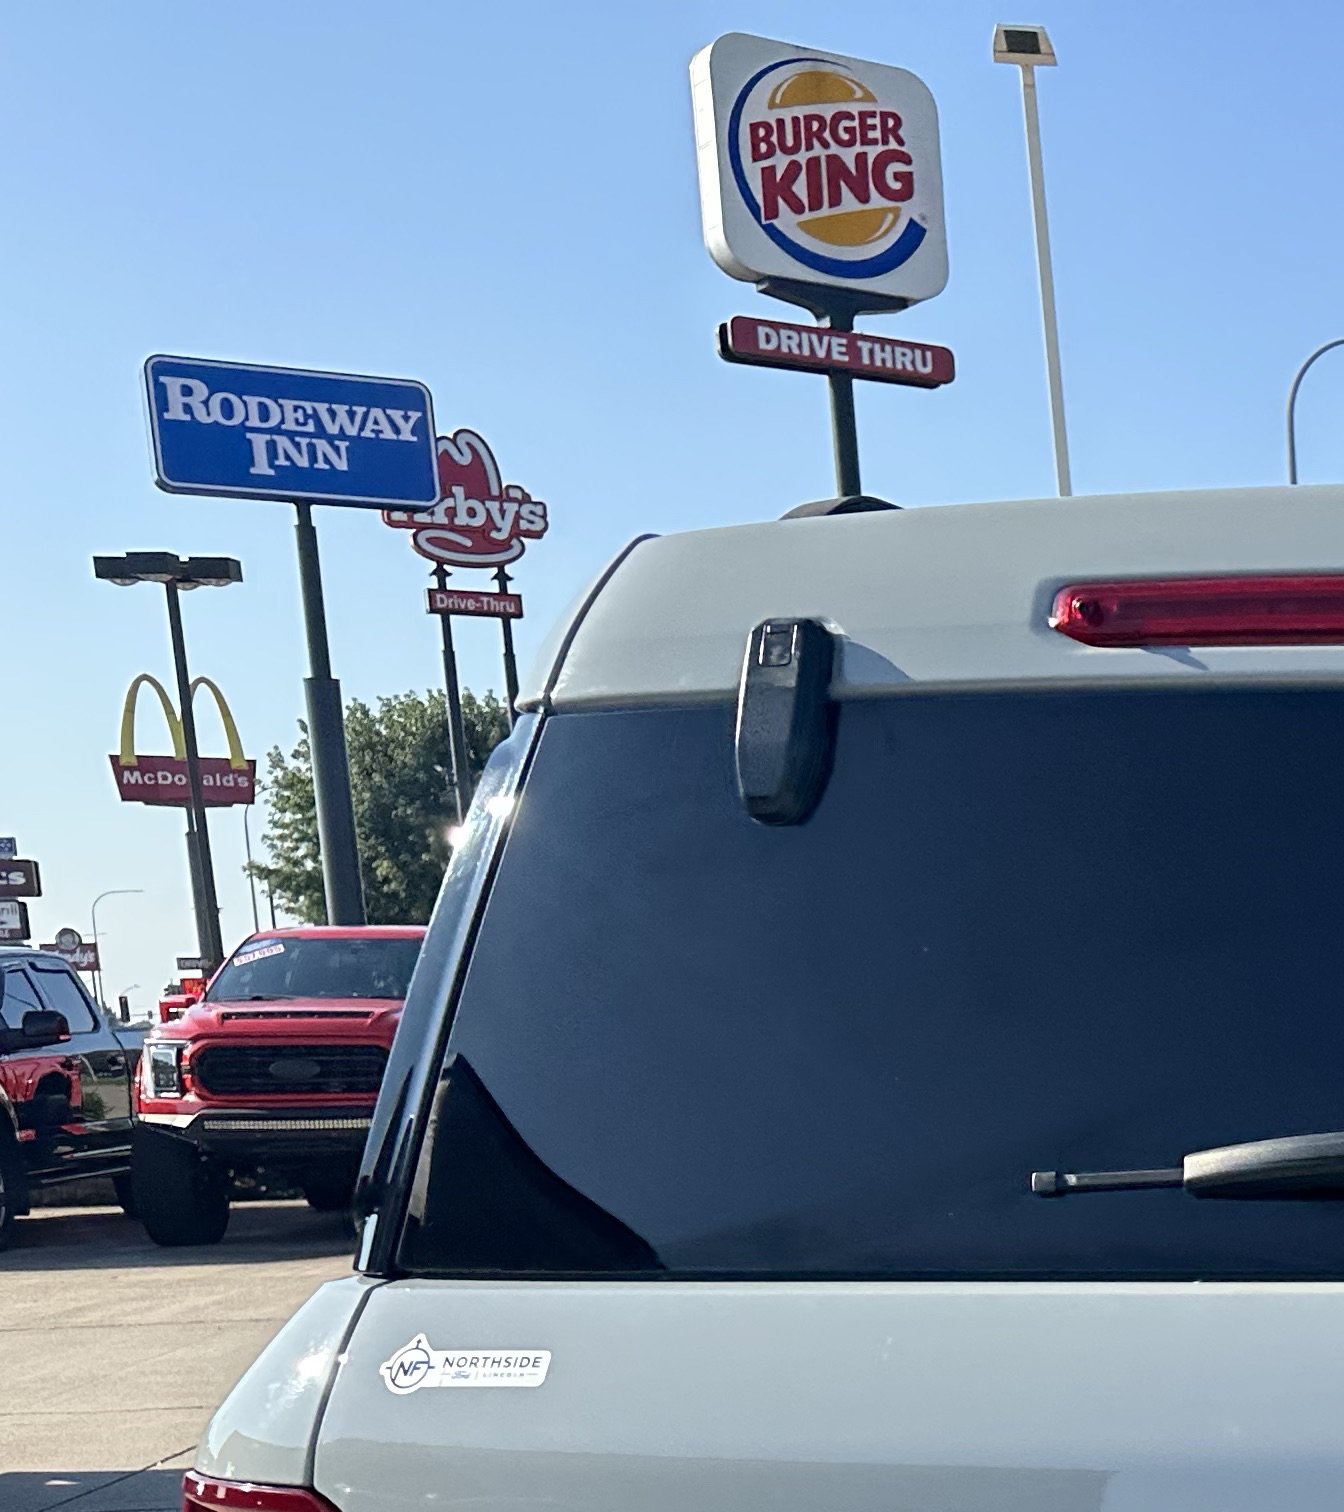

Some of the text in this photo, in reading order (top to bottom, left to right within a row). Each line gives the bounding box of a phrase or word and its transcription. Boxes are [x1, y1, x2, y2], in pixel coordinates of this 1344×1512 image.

[748, 110, 906, 163] BURGER
[761, 148, 914, 222] KING
[757, 325, 934, 374] DRIVE THRU
[158, 375, 423, 442] RODEWAY
[245, 432, 350, 476] INN
[390, 485, 547, 541] rby's
[435, 593, 516, 613] Drive-Thru
[123, 770, 249, 788] McDoald's
[442, 1356, 543, 1369] NORTHSIDE
